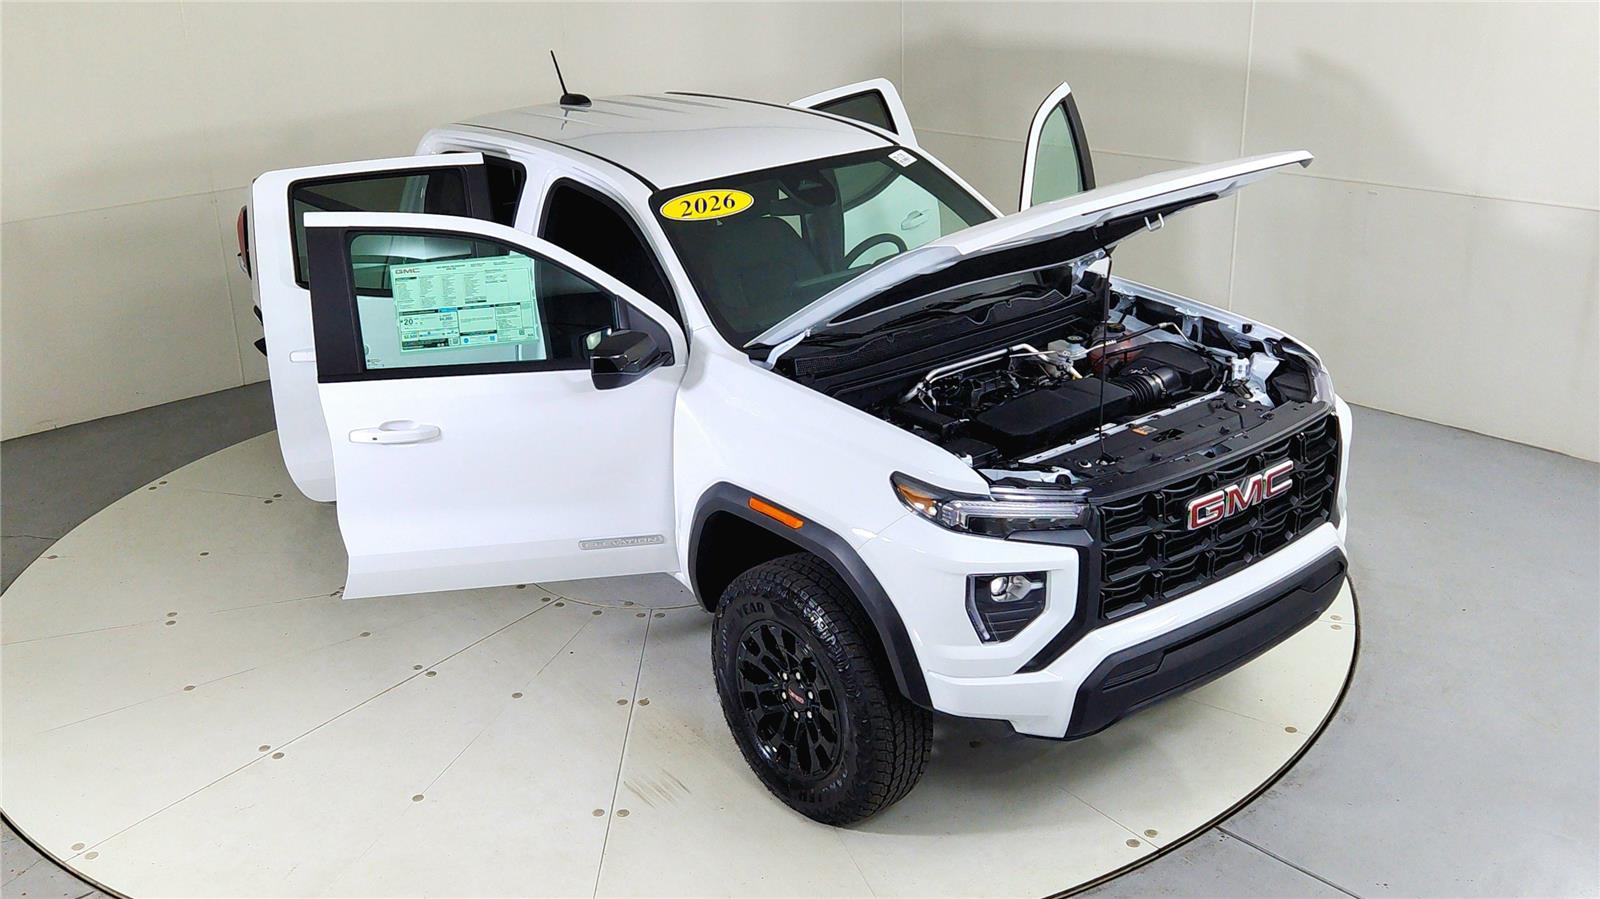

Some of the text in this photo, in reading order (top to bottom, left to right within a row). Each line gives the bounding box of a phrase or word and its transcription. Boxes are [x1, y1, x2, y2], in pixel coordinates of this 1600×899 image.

[679, 193, 736, 217] 2026
[395, 267, 420, 275] GMC
[403, 318, 414, 326] 20
[1187, 459, 1294, 531] GMC
[738, 602, 765, 618] YEAR
